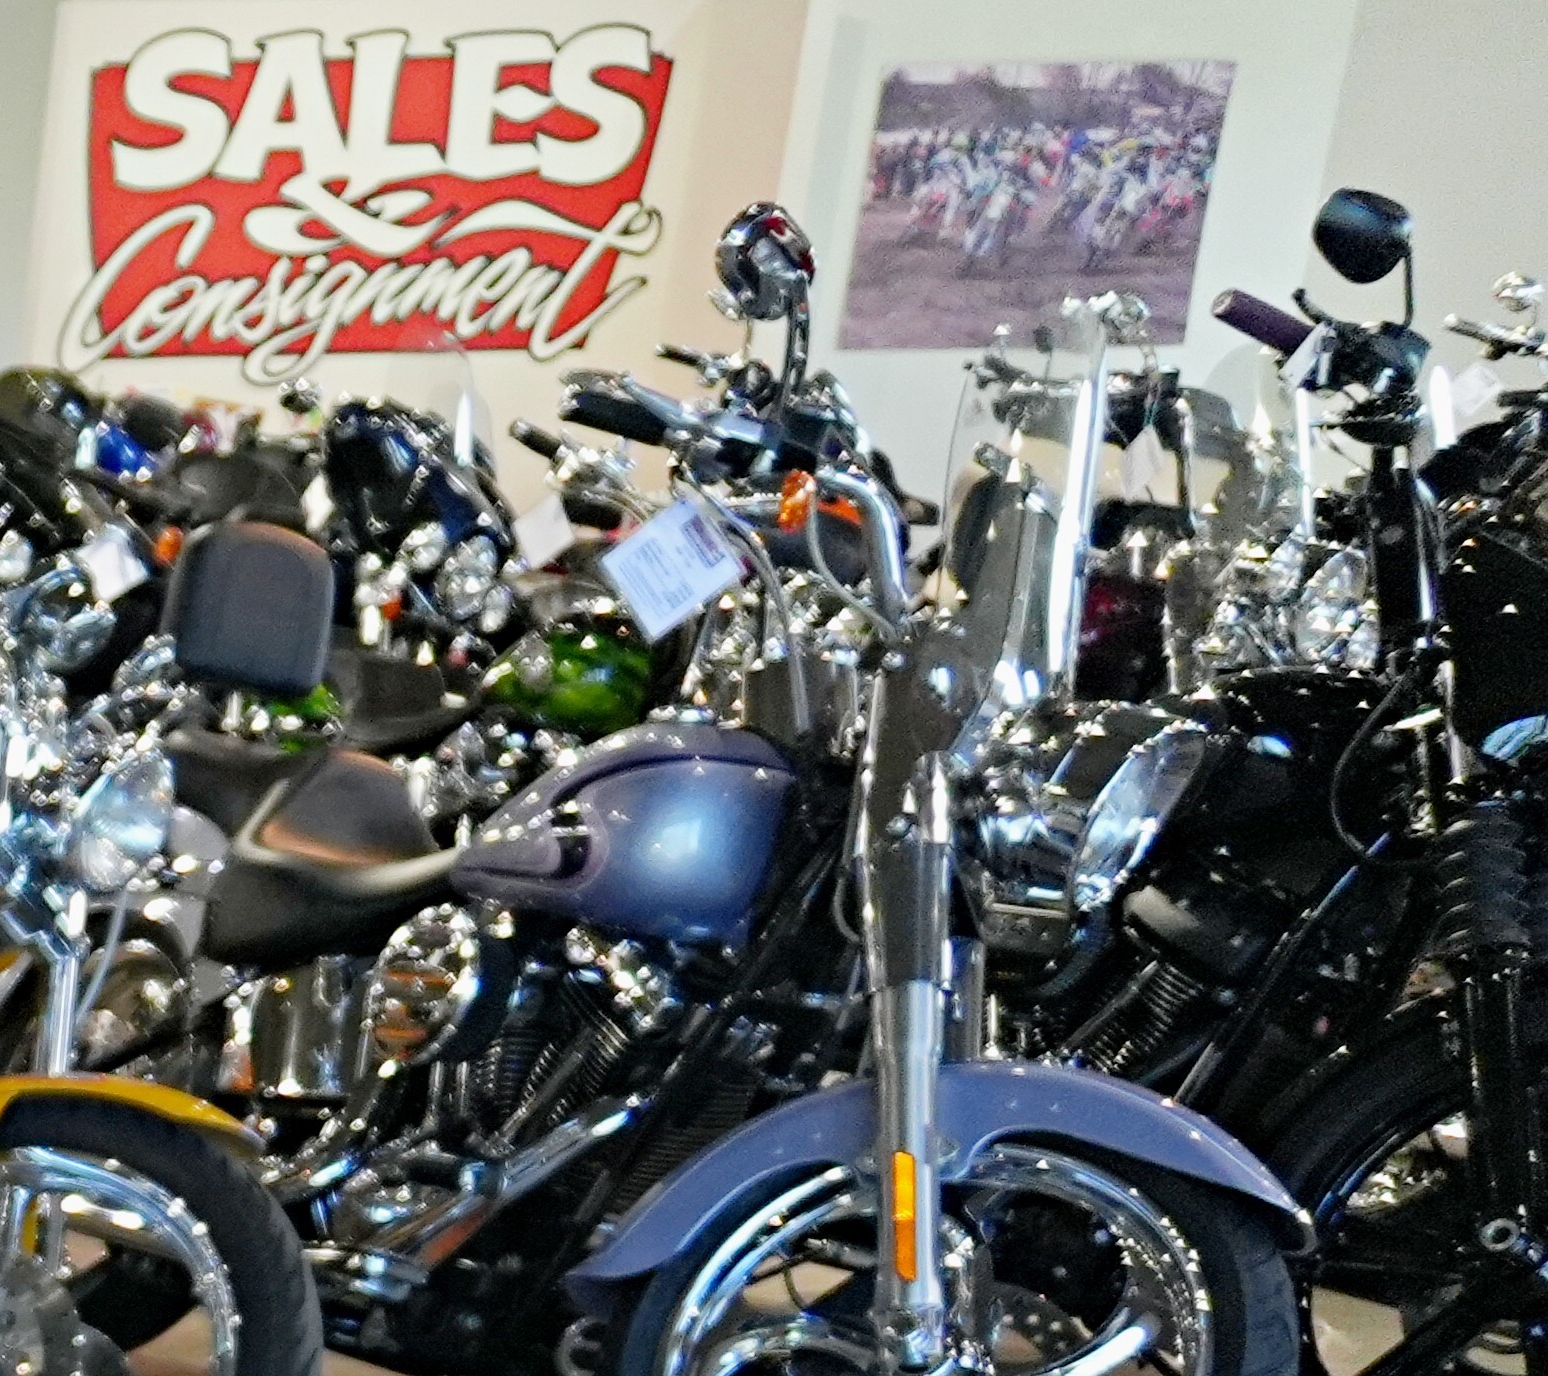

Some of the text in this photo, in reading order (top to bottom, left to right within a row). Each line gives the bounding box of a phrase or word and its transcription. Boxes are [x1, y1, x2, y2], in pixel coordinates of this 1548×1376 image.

[110, 23, 654, 191] SALES
[56, 199, 662, 385] Consignment
[242, 172, 456, 257] &
